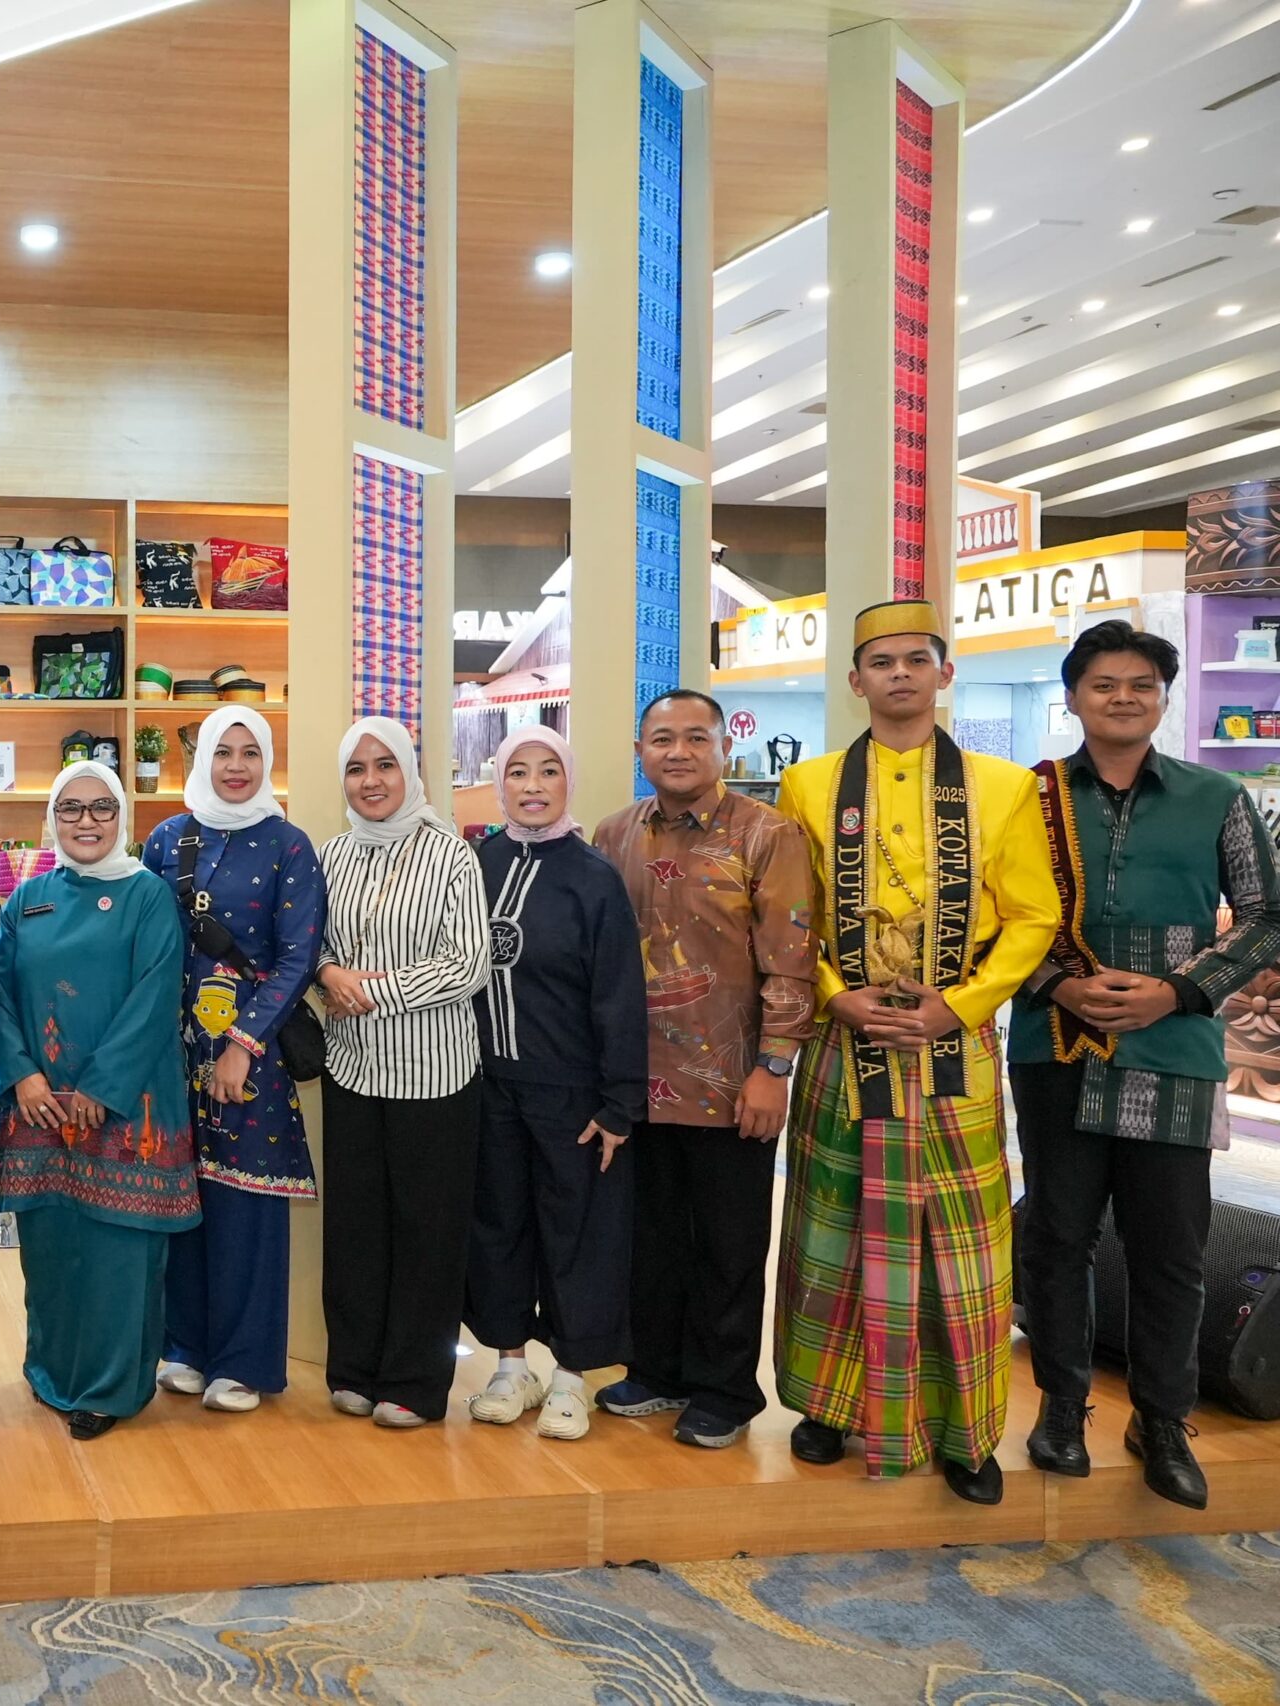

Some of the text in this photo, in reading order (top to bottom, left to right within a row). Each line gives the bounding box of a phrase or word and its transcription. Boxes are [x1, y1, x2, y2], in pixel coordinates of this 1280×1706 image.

[955, 562, 1111, 624] ATIGA
[934, 785, 966, 803] 2025
[936, 815, 968, 889] KOTA
[837, 844, 863, 937] DUTA
